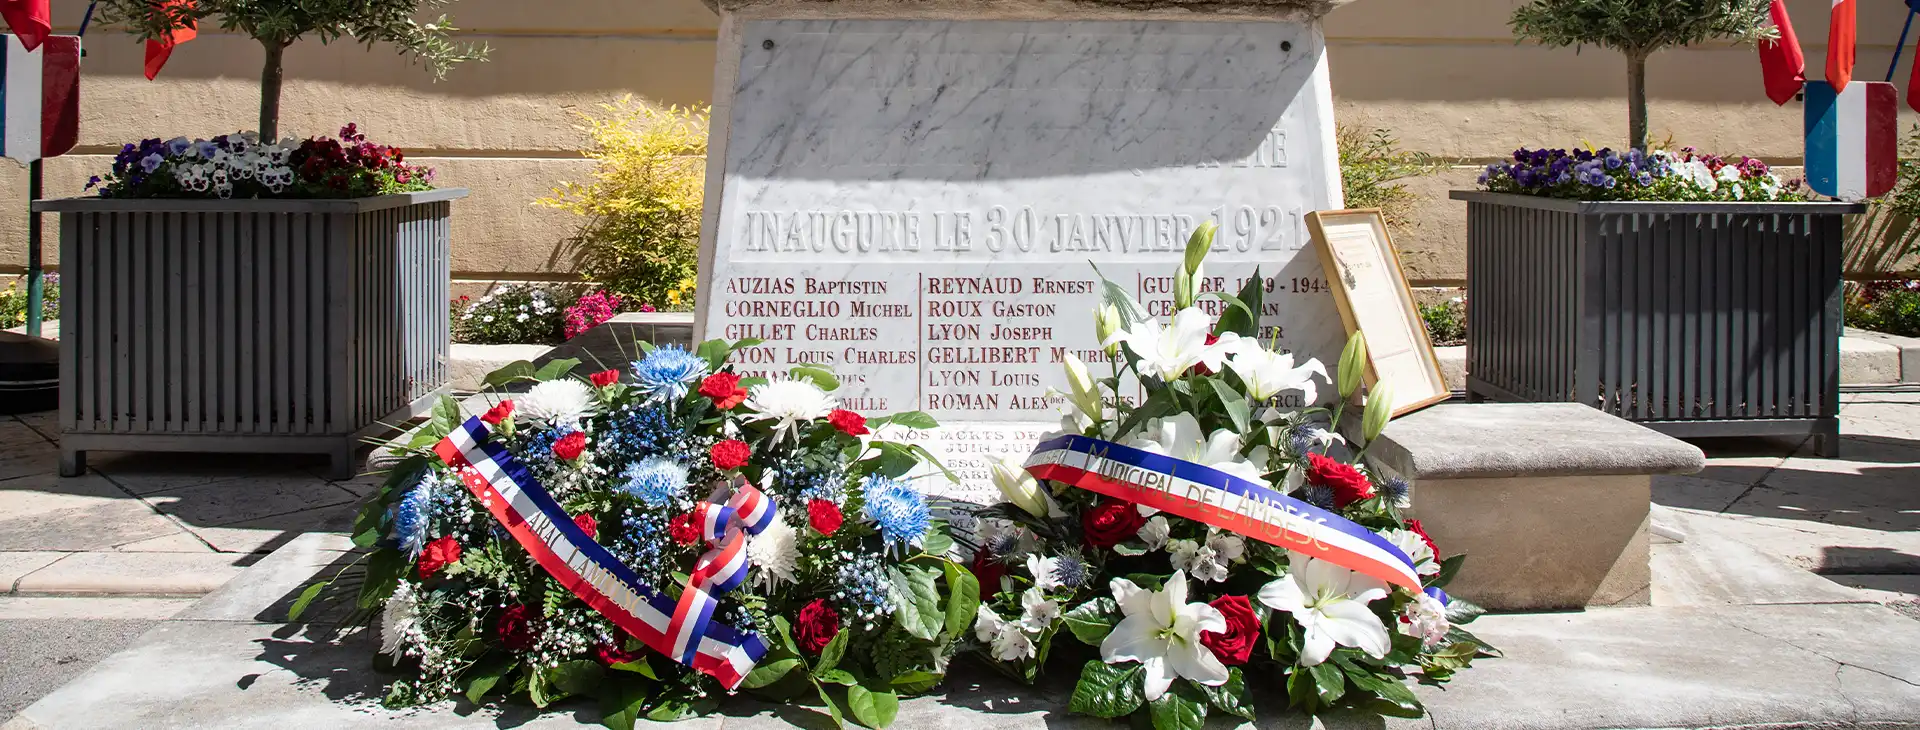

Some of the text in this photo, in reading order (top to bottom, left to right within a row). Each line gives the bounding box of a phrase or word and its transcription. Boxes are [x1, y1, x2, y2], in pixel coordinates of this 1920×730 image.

[933, 210, 973, 252] LE
[986, 204, 1037, 253] 30
[1050, 212, 1195, 254] JANVIER
[1211, 204, 1306, 253] 1921
[726, 277, 795, 295] AUZIAS
[927, 277, 1023, 295] REYNAUD
[1143, 276, 1226, 294] GURE
[725, 300, 841, 318] CORNEGLIO
[927, 300, 983, 318] ROUX
[725, 323, 796, 341] GILLET
[927, 323, 981, 341] LYON
[927, 346, 1041, 364] GELLIBERT
[928, 370, 981, 387] LYON
[928, 393, 999, 410] ROMAN
[893, 430, 931, 441] NOS
[940, 430, 1005, 441] MORTS
